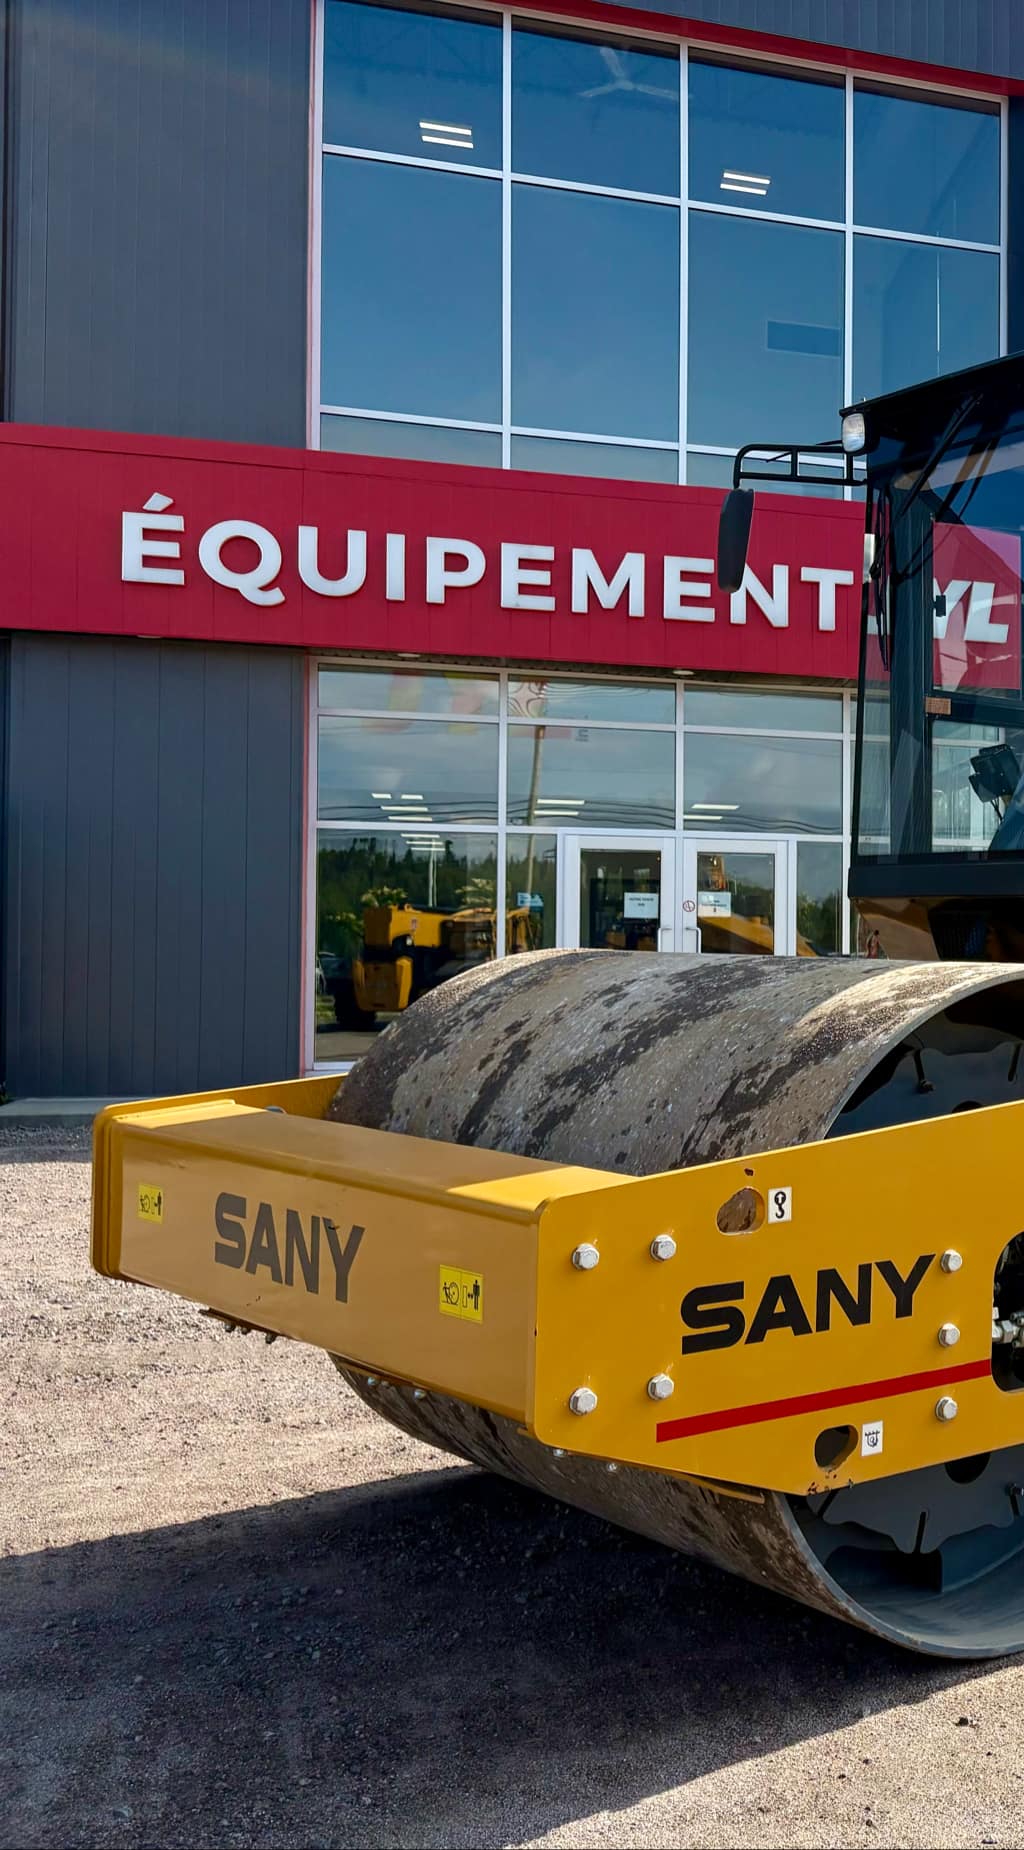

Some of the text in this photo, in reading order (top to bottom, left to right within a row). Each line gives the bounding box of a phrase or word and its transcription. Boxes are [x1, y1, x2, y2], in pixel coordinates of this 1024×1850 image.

[121, 492, 854, 631] ÉQUIPEMENT
[214, 1192, 365, 1303] SANY
[680, 1254, 936, 1355] SANY
